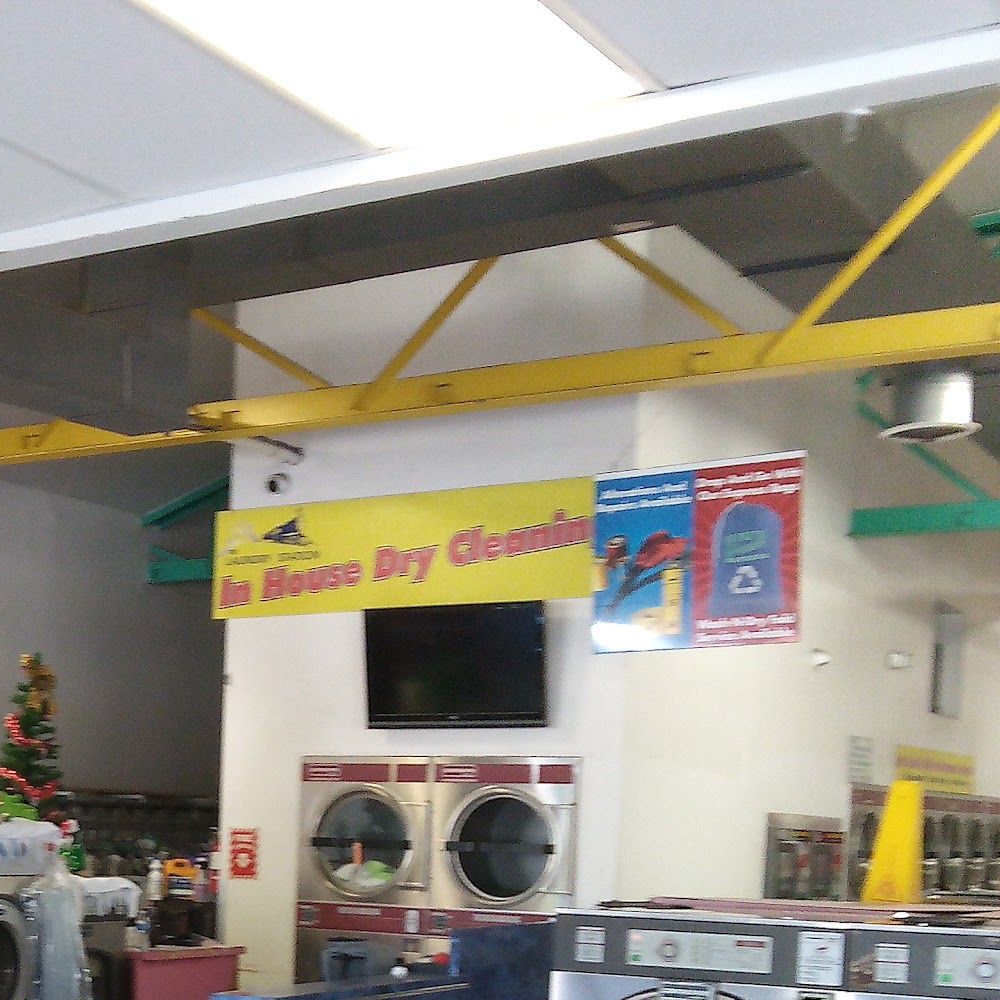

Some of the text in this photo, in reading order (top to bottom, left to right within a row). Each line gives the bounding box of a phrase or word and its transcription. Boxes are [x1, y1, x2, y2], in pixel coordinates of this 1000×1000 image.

[219, 509, 592, 609] In House Dry Cleanin
